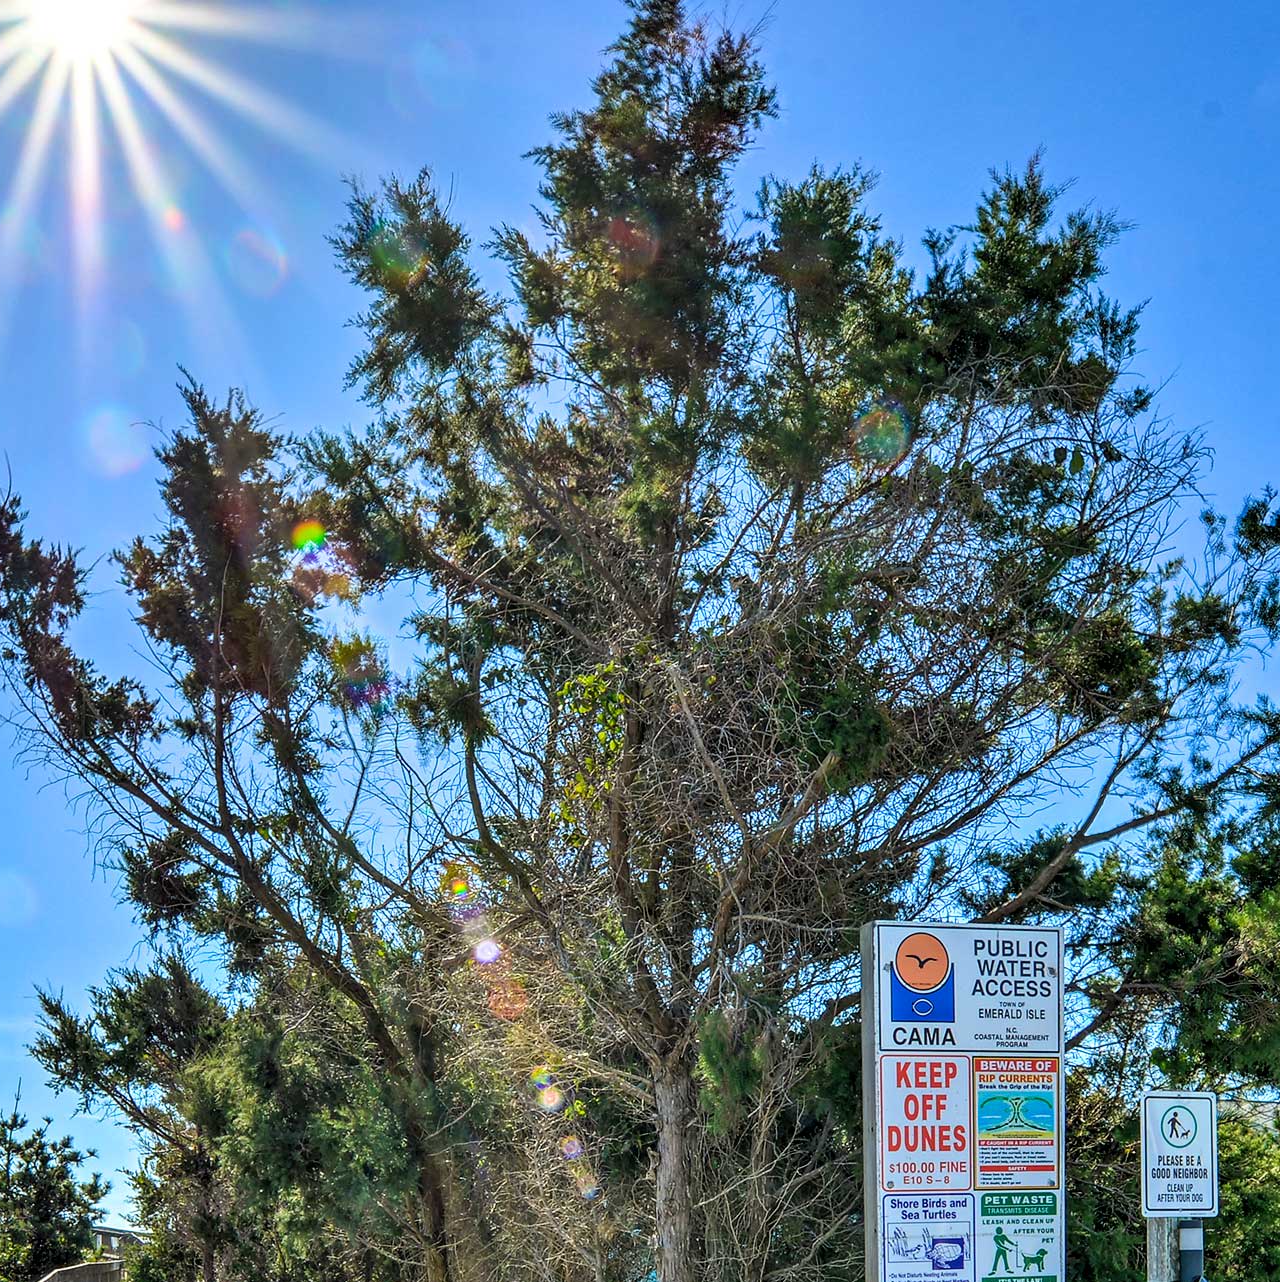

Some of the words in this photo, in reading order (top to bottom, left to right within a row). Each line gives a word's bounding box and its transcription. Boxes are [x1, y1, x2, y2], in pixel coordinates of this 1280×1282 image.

[974, 940, 1048, 957] PUBLIC
[977, 960, 1045, 977] WATER
[972, 980, 1051, 997] ACCESS
[979, 1009, 1022, 1019] EMERALD
[1026, 1009, 1045, 1019] ISLE
[893, 1028, 956, 1046] CAMA
[981, 1061, 1032, 1070] BEWARE
[1036, 1061, 1052, 1070] OF
[896, 1062, 957, 1088] KEEP
[904, 1094, 947, 1120] OFF
[888, 1125, 966, 1152] DUNES
[1158, 1156, 1182, 1166] PLEASE
[1186, 1156, 1194, 1166] BE
[1197, 1156, 1201, 1166] A
[890, 1162, 934, 1173] $100.00
[940, 1162, 966, 1172] FINE
[1152, 1168, 1170, 1179] GOOD
[1173, 1168, 1208, 1179] NEIGHBOR
[904, 1176, 921, 1184] E10
[1167, 1184, 1184, 1192] CLEAN
[1186, 1184, 1193, 1192] UP
[891, 1199, 918, 1208] Shore
[922, 1198, 946, 1208] Birds
[950, 1198, 967, 1208] and
[985, 1197, 1007, 1205] PET
[1011, 1196, 1053, 1204] WASTE
[1158, 1194, 1174, 1202] AFTER
[1176, 1194, 1190, 1202] YOUR
[1192, 1194, 1203, 1202] DOG
[902, 1210, 919, 1219] Sea
[923, 1210, 956, 1219] Turtles
